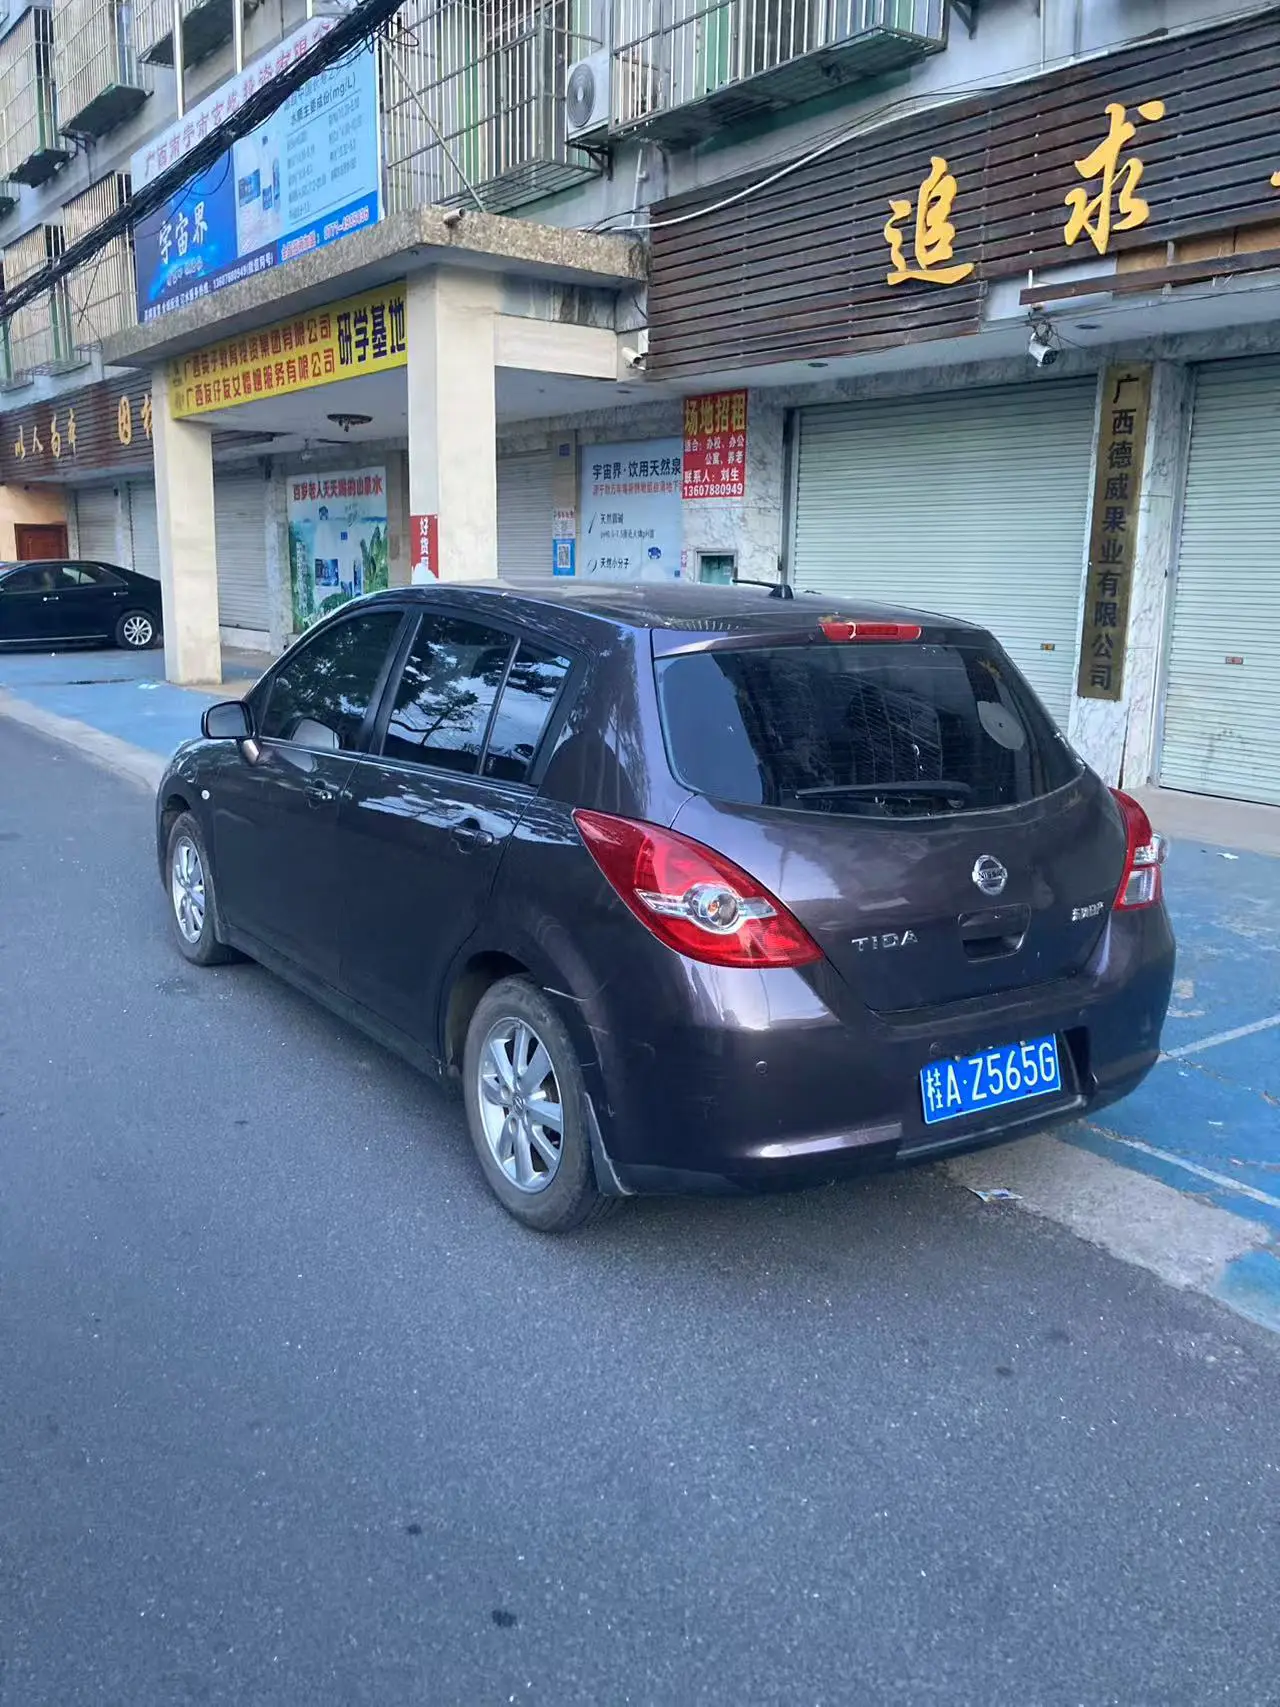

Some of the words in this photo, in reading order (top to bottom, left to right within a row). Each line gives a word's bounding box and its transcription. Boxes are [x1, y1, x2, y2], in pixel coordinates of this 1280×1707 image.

[159, 200, 208, 265] 宇宙界
[336, 298, 406, 367] 研学基地
[685, 393, 746, 436] 场地招租
[683, 483, 743, 498] 13607880949
[1089, 373, 1140, 692] 广西德威果业有限公司
[851, 929, 919, 952] TIDA
